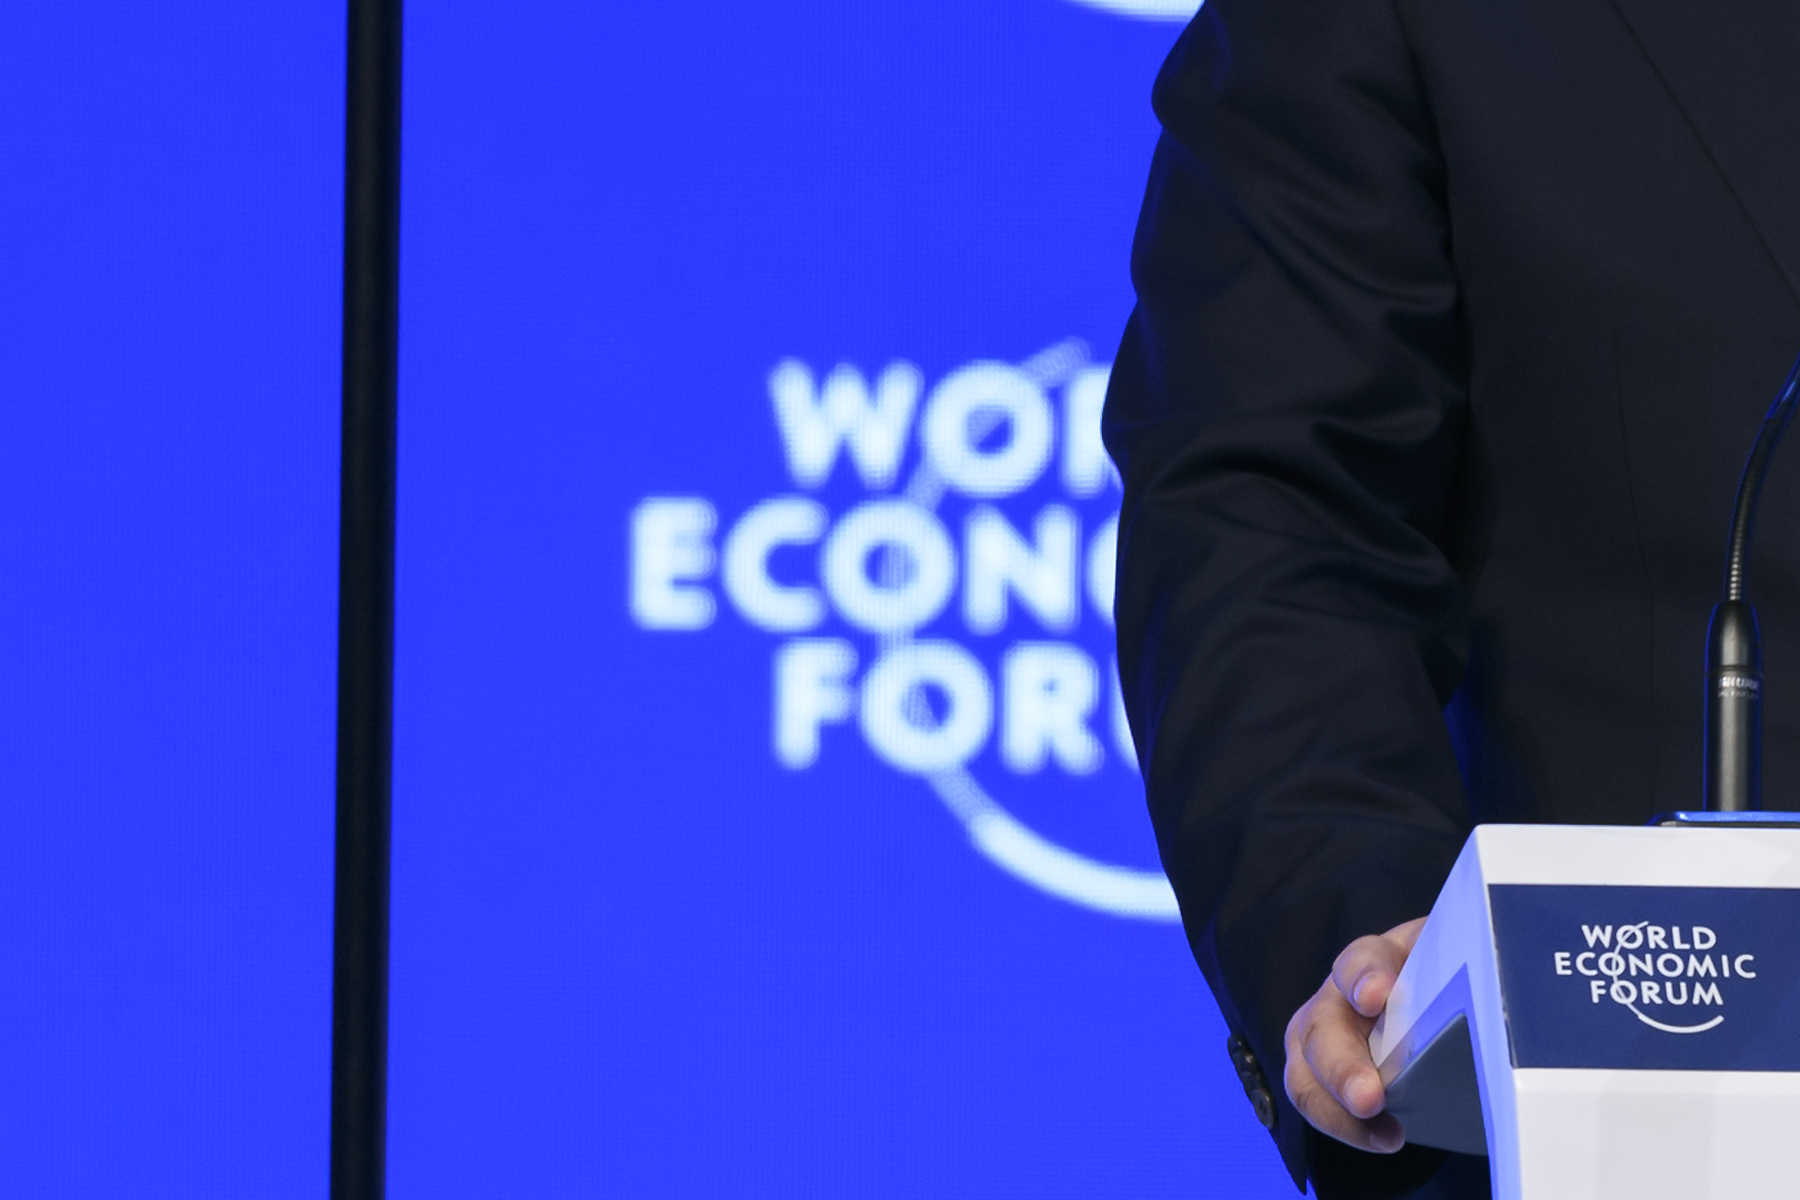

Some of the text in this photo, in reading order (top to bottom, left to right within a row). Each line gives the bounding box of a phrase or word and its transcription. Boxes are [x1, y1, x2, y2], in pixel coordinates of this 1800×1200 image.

[629, 495, 1119, 636] ECON
[772, 636, 1141, 777] FOR
[1581, 924, 1717, 950] WORLD
[1554, 952, 1757, 978] ECONOMIC
[1590, 980, 1724, 1006] FORUM
